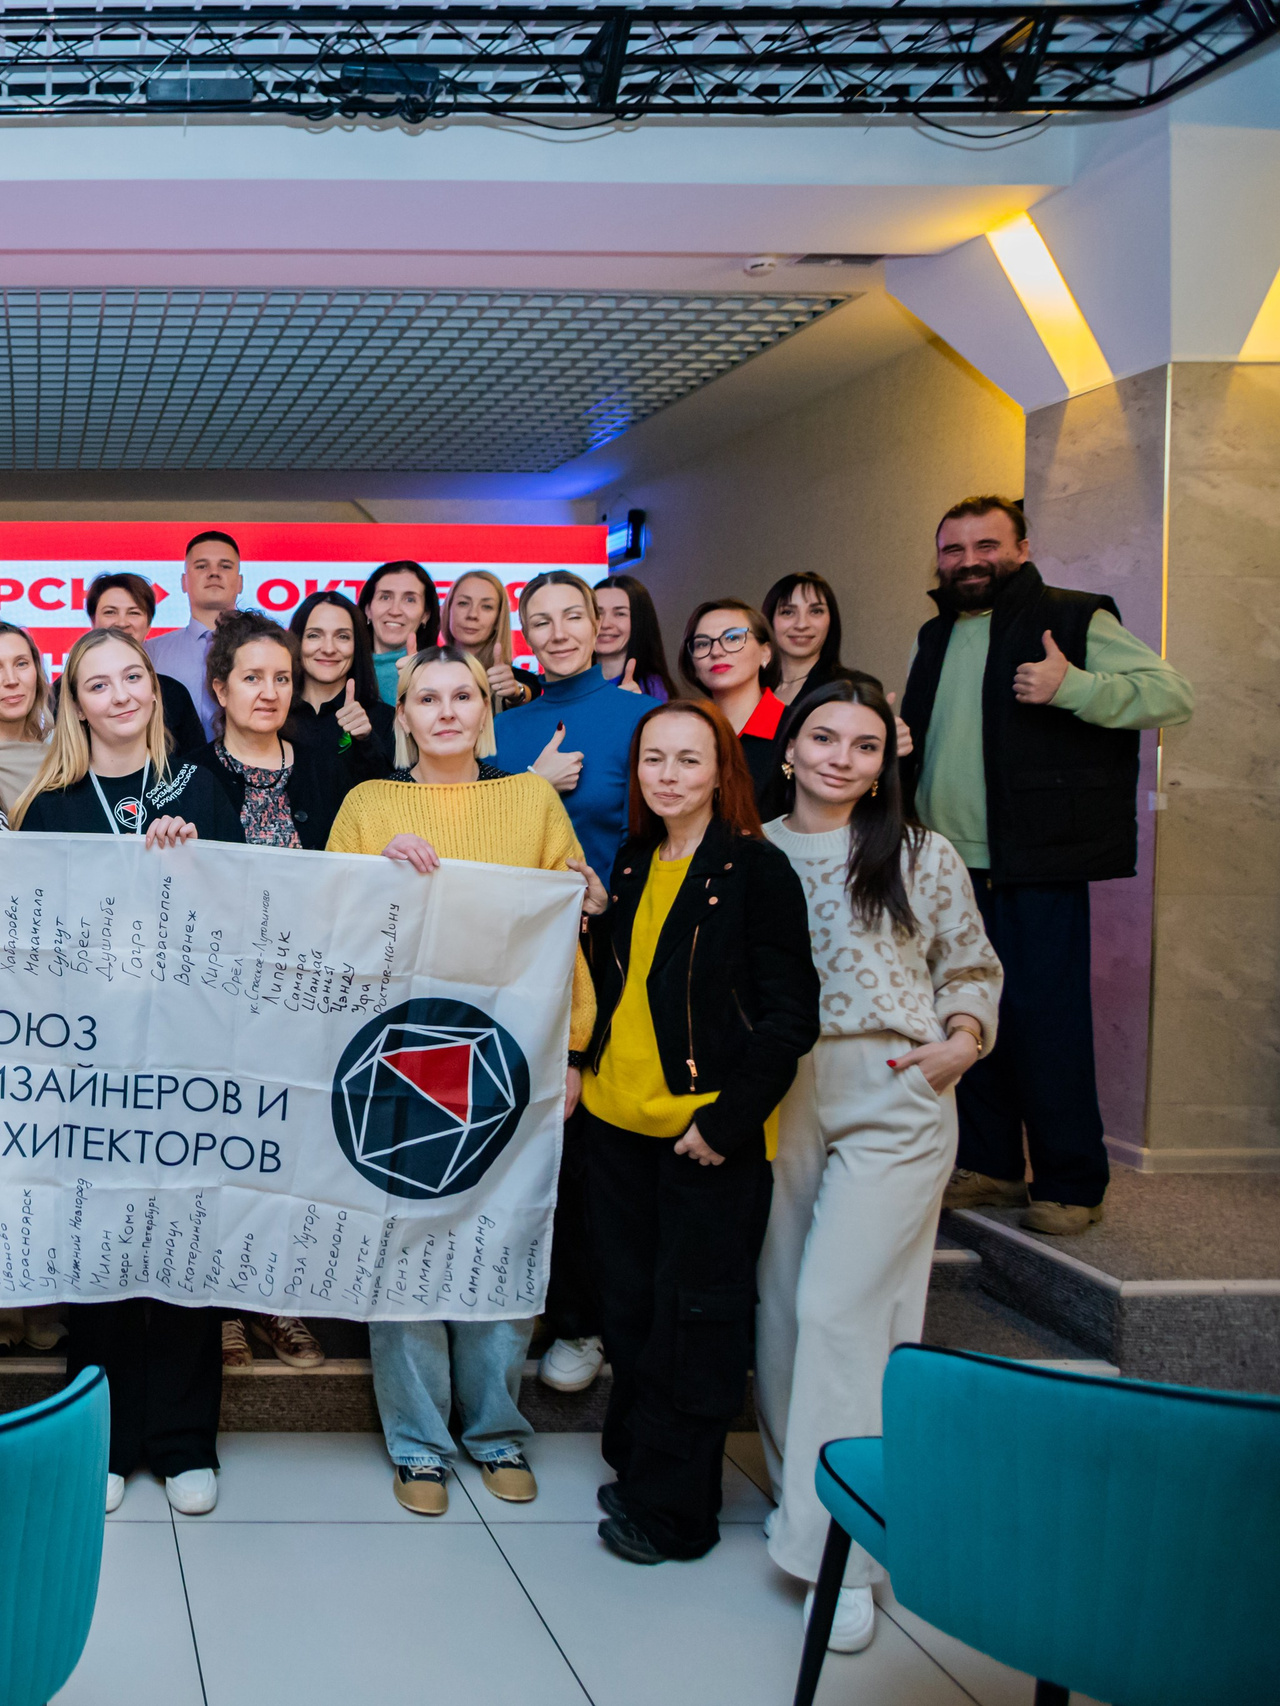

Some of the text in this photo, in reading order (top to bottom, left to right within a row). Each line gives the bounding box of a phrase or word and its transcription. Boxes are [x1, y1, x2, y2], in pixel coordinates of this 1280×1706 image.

[156, 764, 198, 810] АРХИТЕКТОРОВ
[1, 895, 19, 974] Хабаровск
[23, 888, 44, 976] Махачкала
[48, 916, 72, 977] Сургут
[71, 916, 91, 975] Брест
[95, 896, 116, 982] Душанбе
[122, 920, 145, 979] Гагра
[150, 875, 171, 982] Севастополь
[173, 909, 197, 986] Воронеж
[200, 929, 223, 989] Киров
[222, 958, 243, 996] Орёл
[262, 931, 291, 1005] Липецк
[284, 953, 310, 1012] Самара
[302, 948, 322, 1011] Шанхай
[351, 984, 376, 1015] Уфа
[259, 1086, 287, 1121] И
[20, 1189, 35, 1292] Красноярск
[64, 1178, 92, 1291] Нижний Новгород
[119, 1203, 134, 1244] Комо
[135, 1195, 157, 1283] Санкт-Петербург
[156, 1220, 182, 1288] Барнаул
[178, 1189, 207, 1293] Екатеринбург
[293, 1203, 321, 1249] Хутор
[374, 1214, 398, 1269] Байкал
[39, 1248, 61, 1289] Уфа
[89, 1230, 112, 1289] Милан
[204, 1248, 228, 1292] Тверь
[227, 1232, 257, 1293] Казань
[258, 1252, 278, 1297] Сочи
[311, 1210, 347, 1301] Барселона
[341, 1234, 372, 1305] Иркутск
[436, 1229, 457, 1303] Ташкент
[460, 1214, 496, 1307] Самарканд
[488, 1246, 510, 1307] Ереван
[516, 1238, 539, 1304] Тюмень
